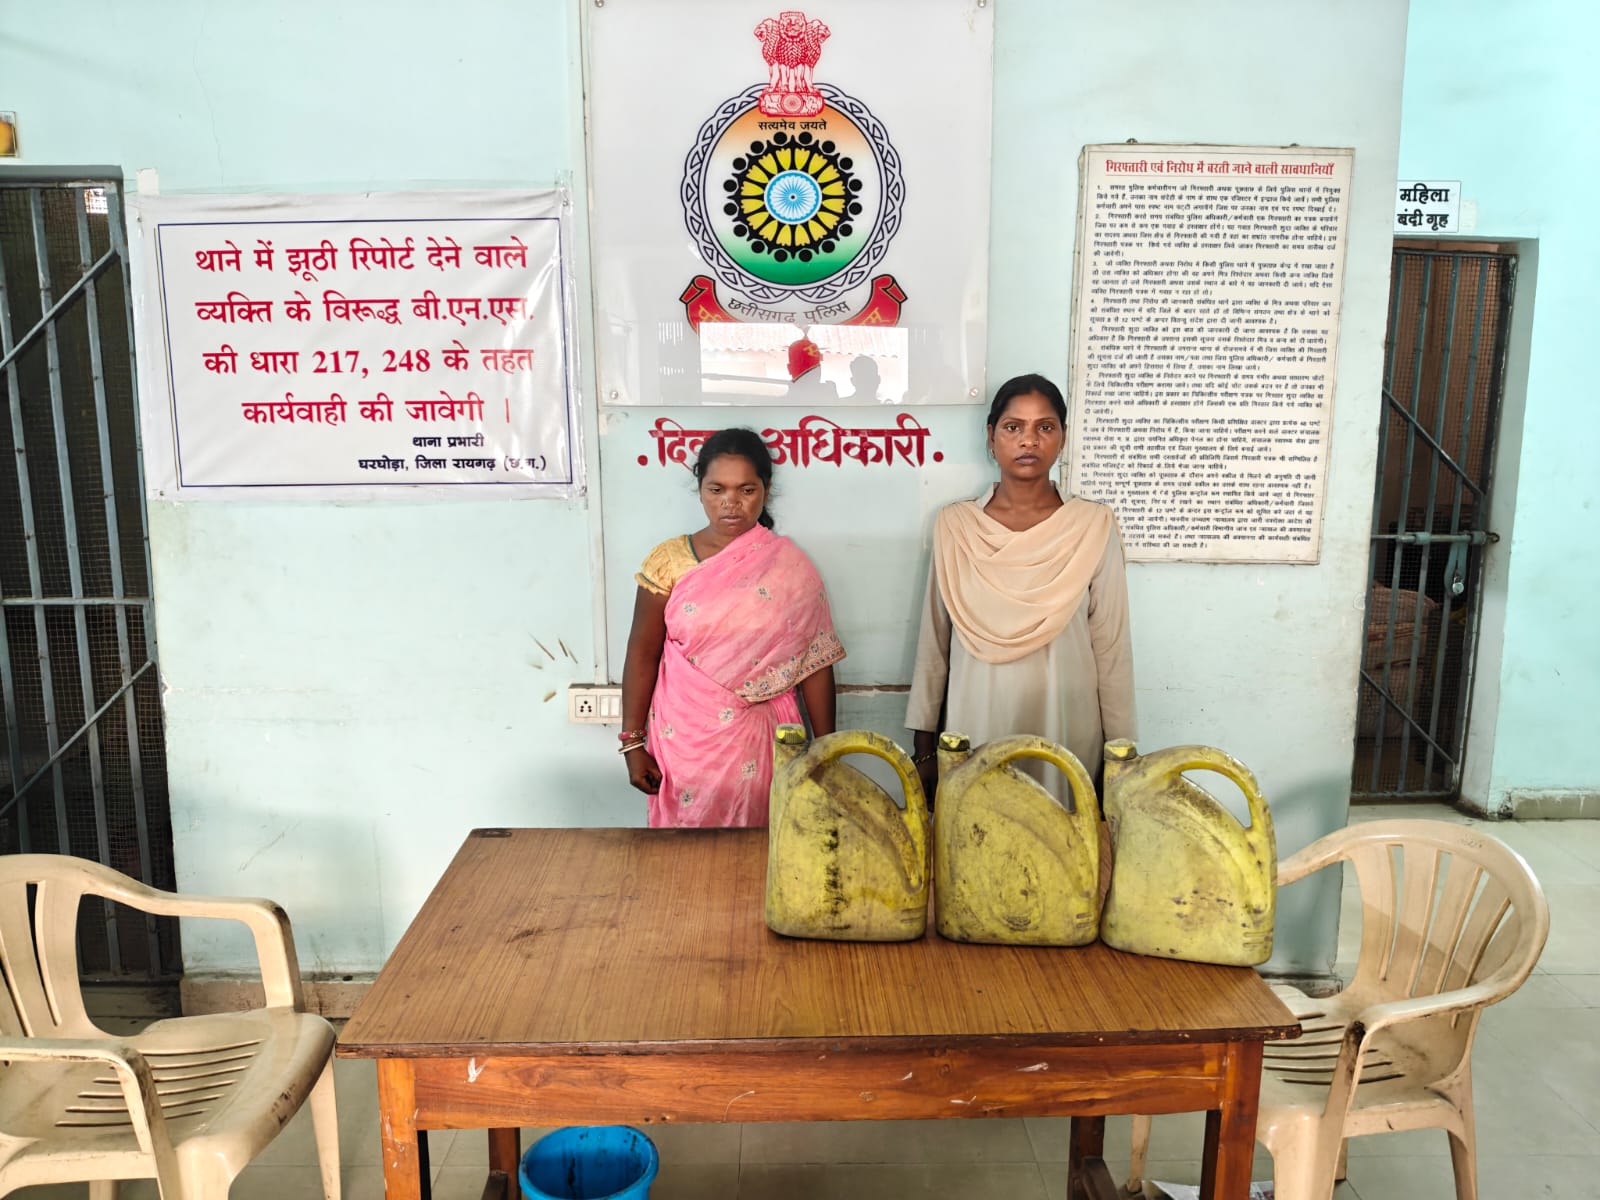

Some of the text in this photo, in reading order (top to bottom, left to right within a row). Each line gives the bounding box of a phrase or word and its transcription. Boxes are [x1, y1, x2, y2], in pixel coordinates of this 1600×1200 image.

[758, 119, 827, 130] सत्यमेव जयते
[1151, 160, 1163, 173] एवं
[1167, 160, 1194, 173] निरोध
[1207, 161, 1229, 173] बरती
[1232, 161, 1252, 174] जाने
[1255, 161, 1278, 174] वाली
[1399, 183, 1450, 204] महिला
[1397, 208, 1449, 231] बंदी गृह
[195, 235, 528, 281] थाने में झूठी रिपोर्ट देने वाले
[195, 289, 534, 326] व्यक्ति के विरूद्ध बी.एन.एस.
[803, 301, 850, 323] पुलिस
[202, 340, 534, 378] की धारा 217, 248 के तहत
[241, 392, 347, 426] कार्यवाही
[358, 392, 394, 423] की
[405, 390, 485, 423] जावेगी
[412, 433, 485, 449] थाना प्रभारी
[761, 413, 931, 468] अधिकारी
[358, 456, 409, 472] घरघोड़ा,
[415, 455, 447, 471] जिला
[452, 457, 496, 472] रायगढ़
